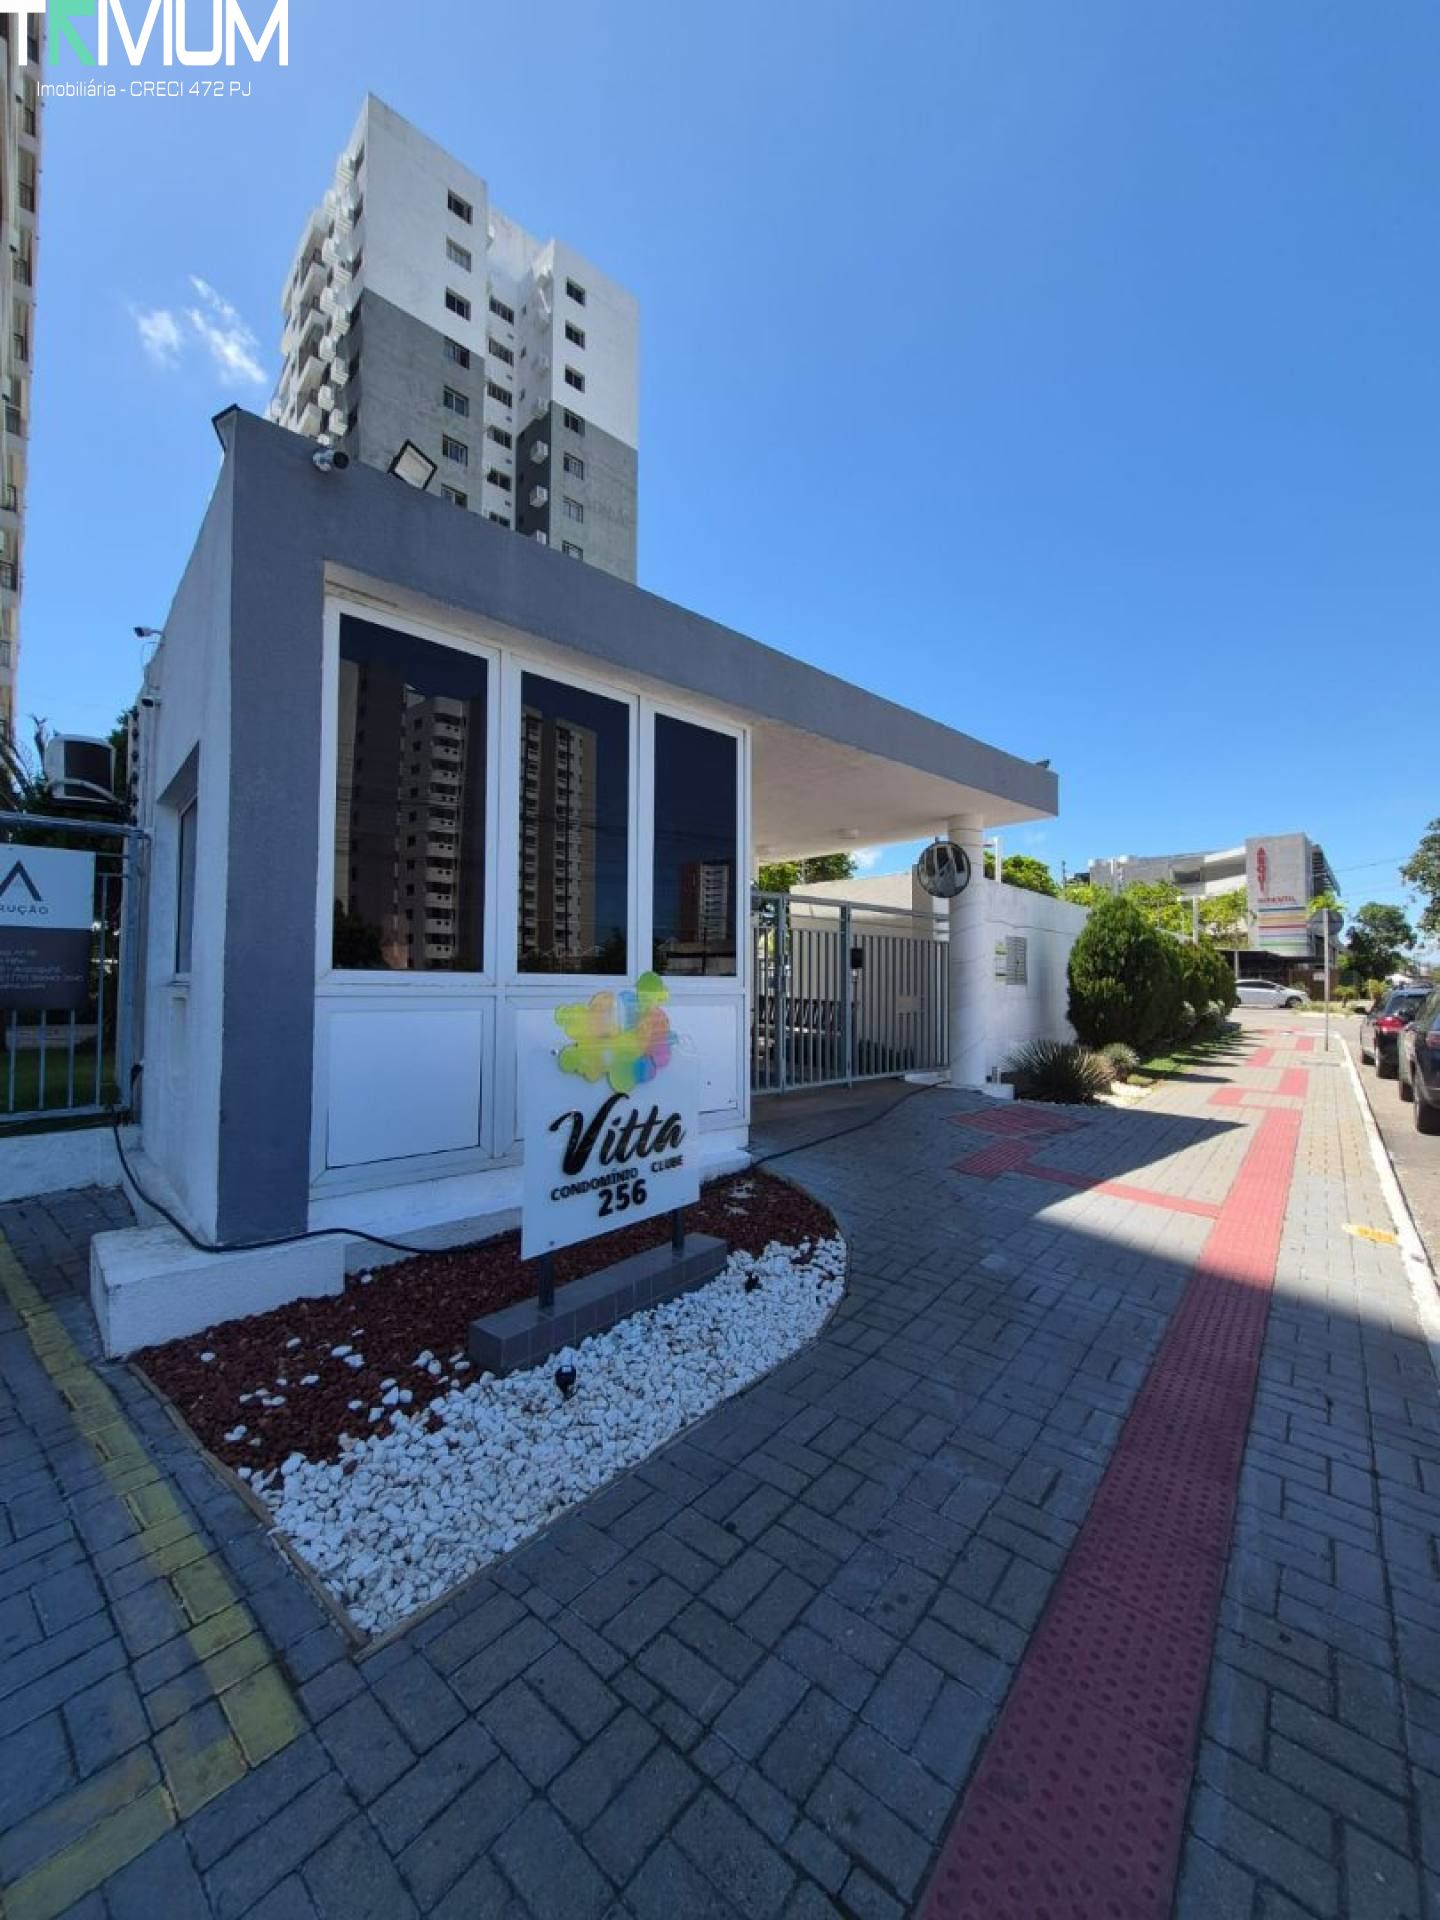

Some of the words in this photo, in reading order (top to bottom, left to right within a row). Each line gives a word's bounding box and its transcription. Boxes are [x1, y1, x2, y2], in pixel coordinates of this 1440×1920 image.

[548, 1092, 686, 1176] Vitta
[651, 1155, 684, 1172] CLUBE
[598, 1178, 648, 1217] 256
